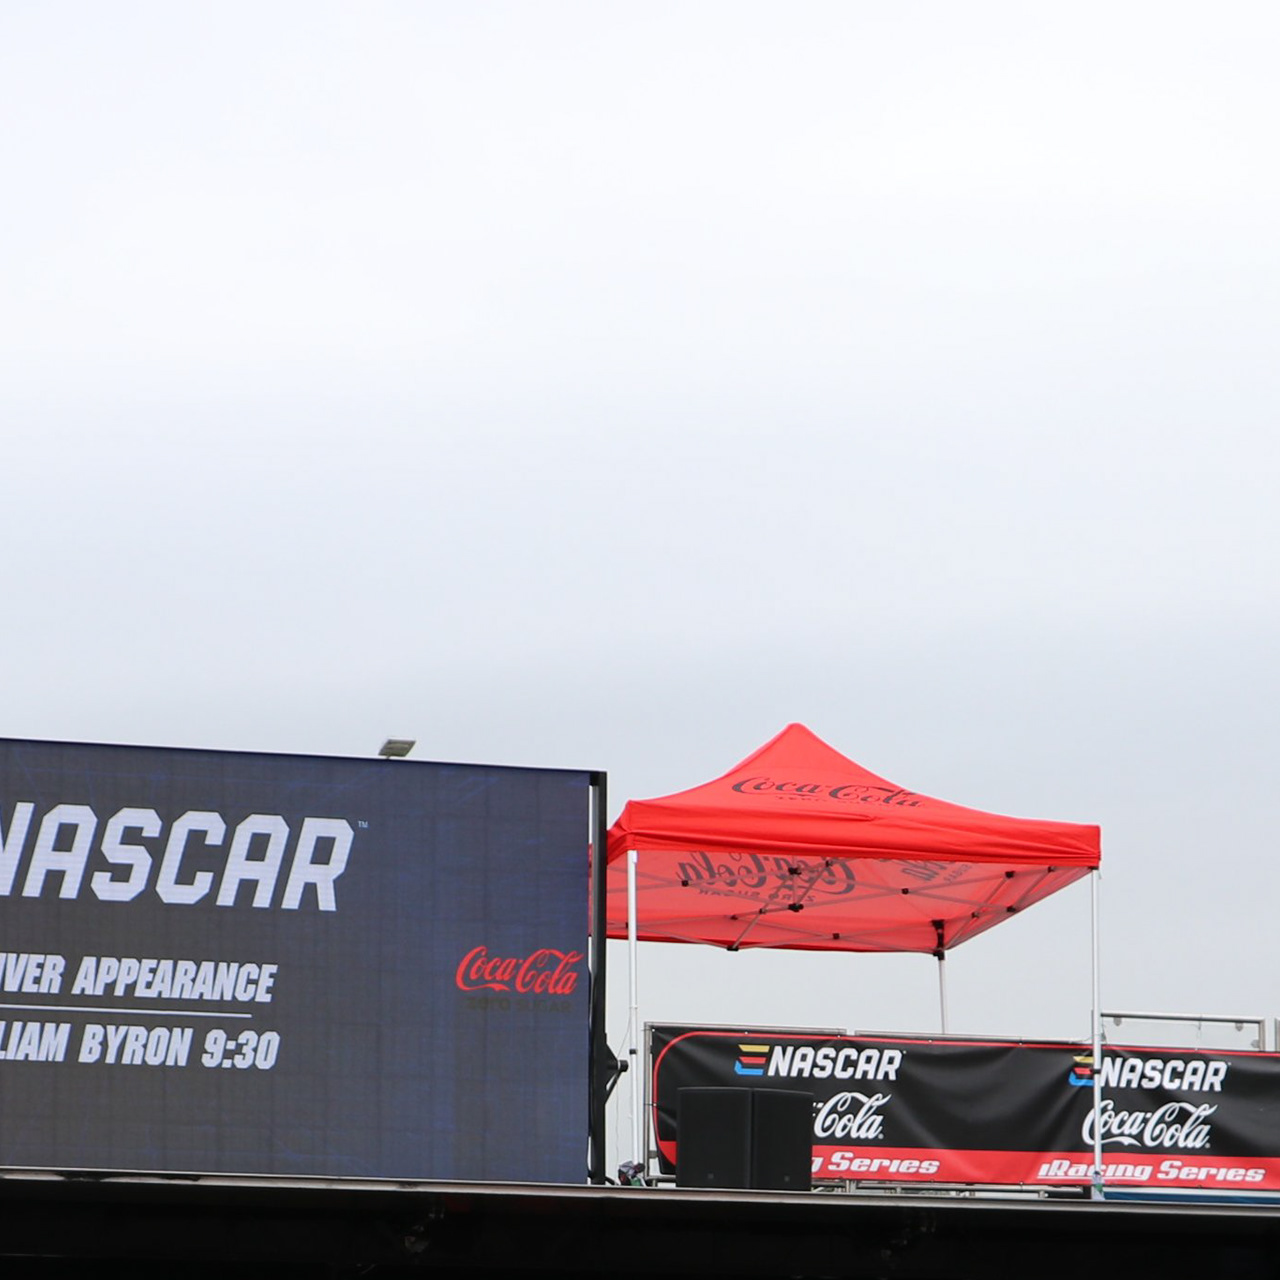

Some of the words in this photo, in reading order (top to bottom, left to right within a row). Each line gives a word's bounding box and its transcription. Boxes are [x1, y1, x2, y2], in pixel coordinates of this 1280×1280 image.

[71, 954, 277, 1003] APPEARANCE
[78, 1023, 192, 1068] BYRON
[201, 1028, 280, 1071] 9:30
[827, 1151, 941, 1175] Series
[1156, 1160, 1266, 1183] Series
